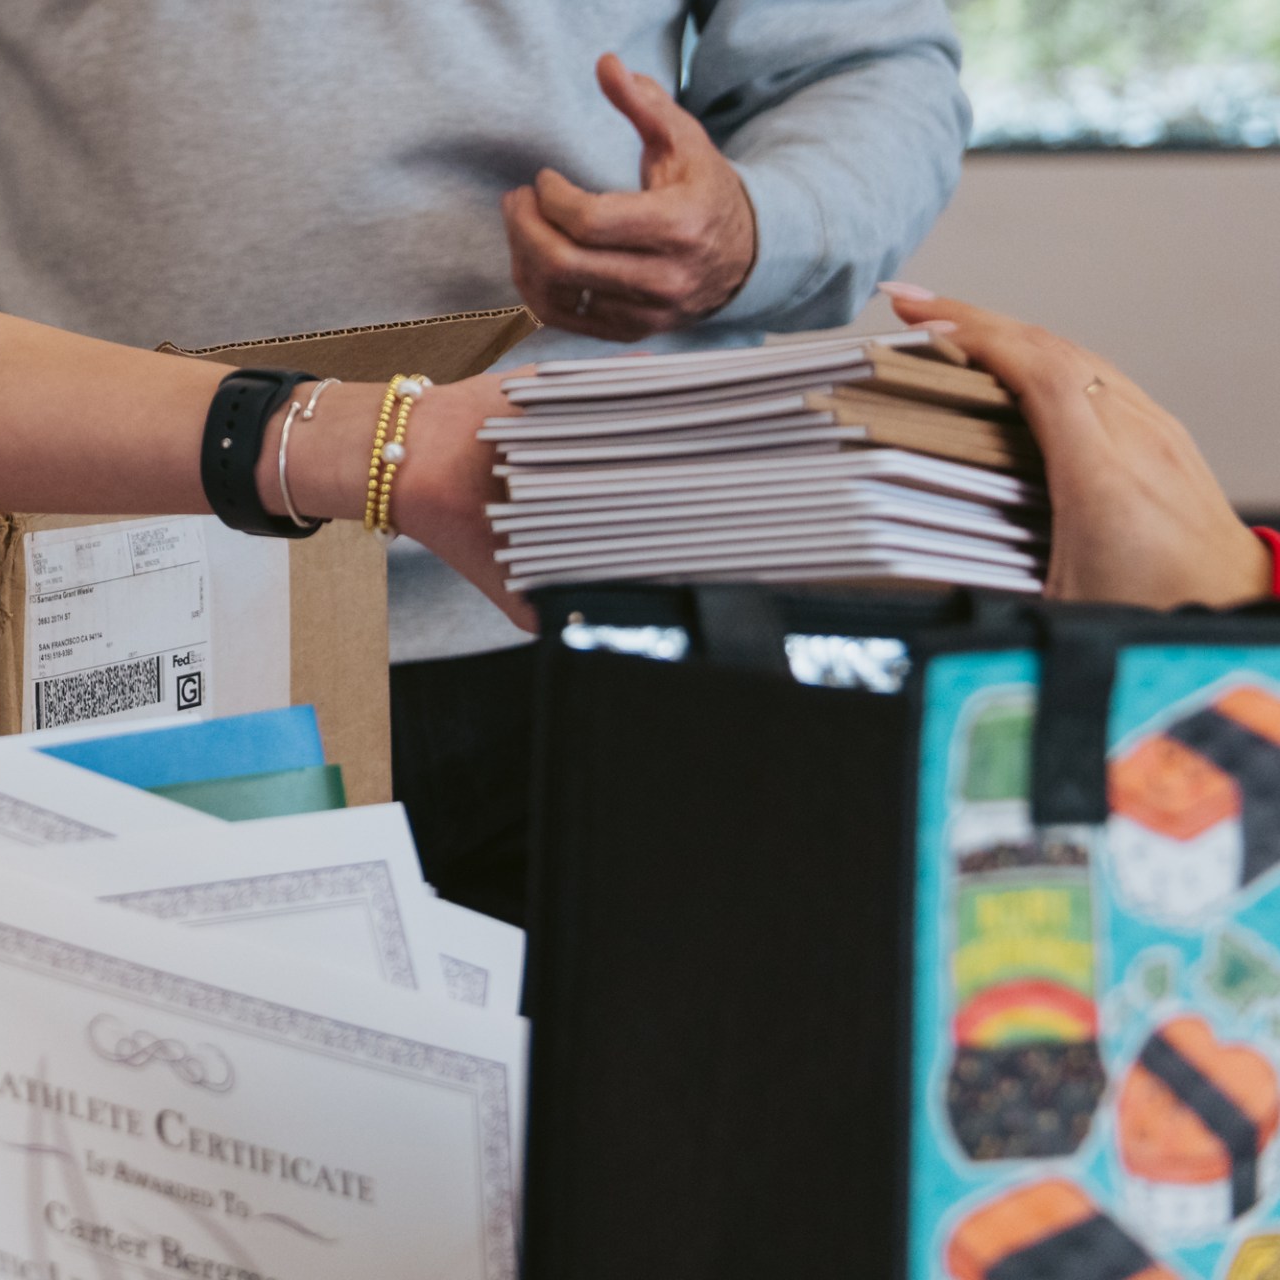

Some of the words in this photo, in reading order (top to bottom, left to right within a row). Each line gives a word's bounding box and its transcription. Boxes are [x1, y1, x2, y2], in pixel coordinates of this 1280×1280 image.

[38, 642, 51, 652] SAN
[51, 635, 80, 650] FRANCISCO
[181, 677, 198, 704] G
[43, 1200, 149, 1258] Carter
